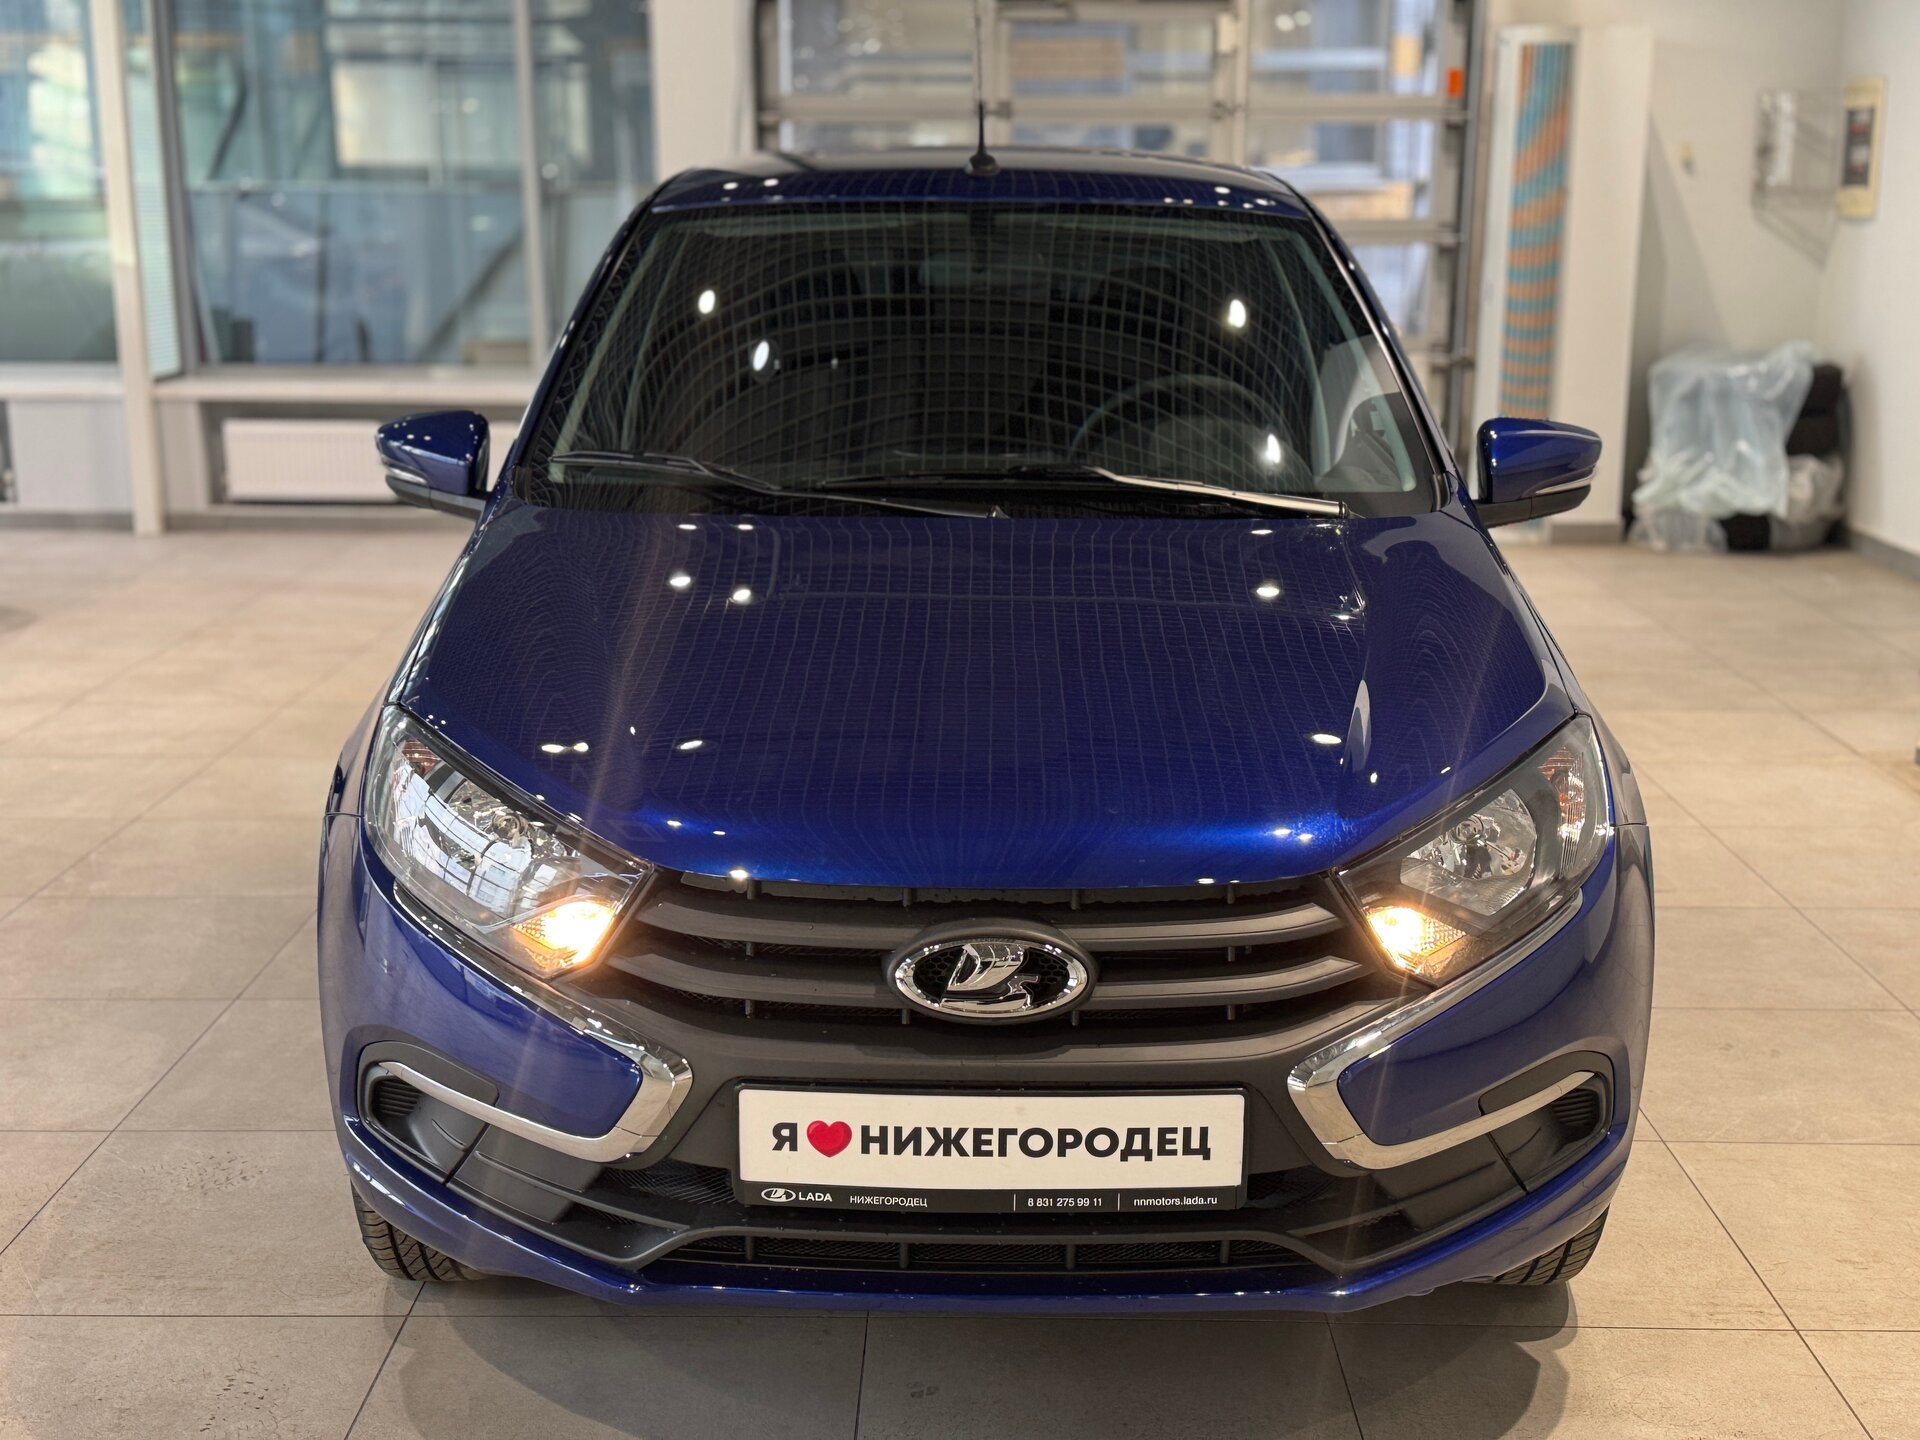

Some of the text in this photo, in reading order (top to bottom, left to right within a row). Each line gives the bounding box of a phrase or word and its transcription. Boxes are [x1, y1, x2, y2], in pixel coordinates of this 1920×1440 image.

[772, 1122, 1211, 1162] Я НИЖЕГОРОДЕЦ
[798, 1191, 833, 1202] LADA
[849, 1195, 928, 1208] НИЖЕГОРОДЕЦ
[1027, 1197, 1102, 1207] 8 831 275 99 11
[1133, 1196, 1218, 1207] nnmotors.lada.ru
